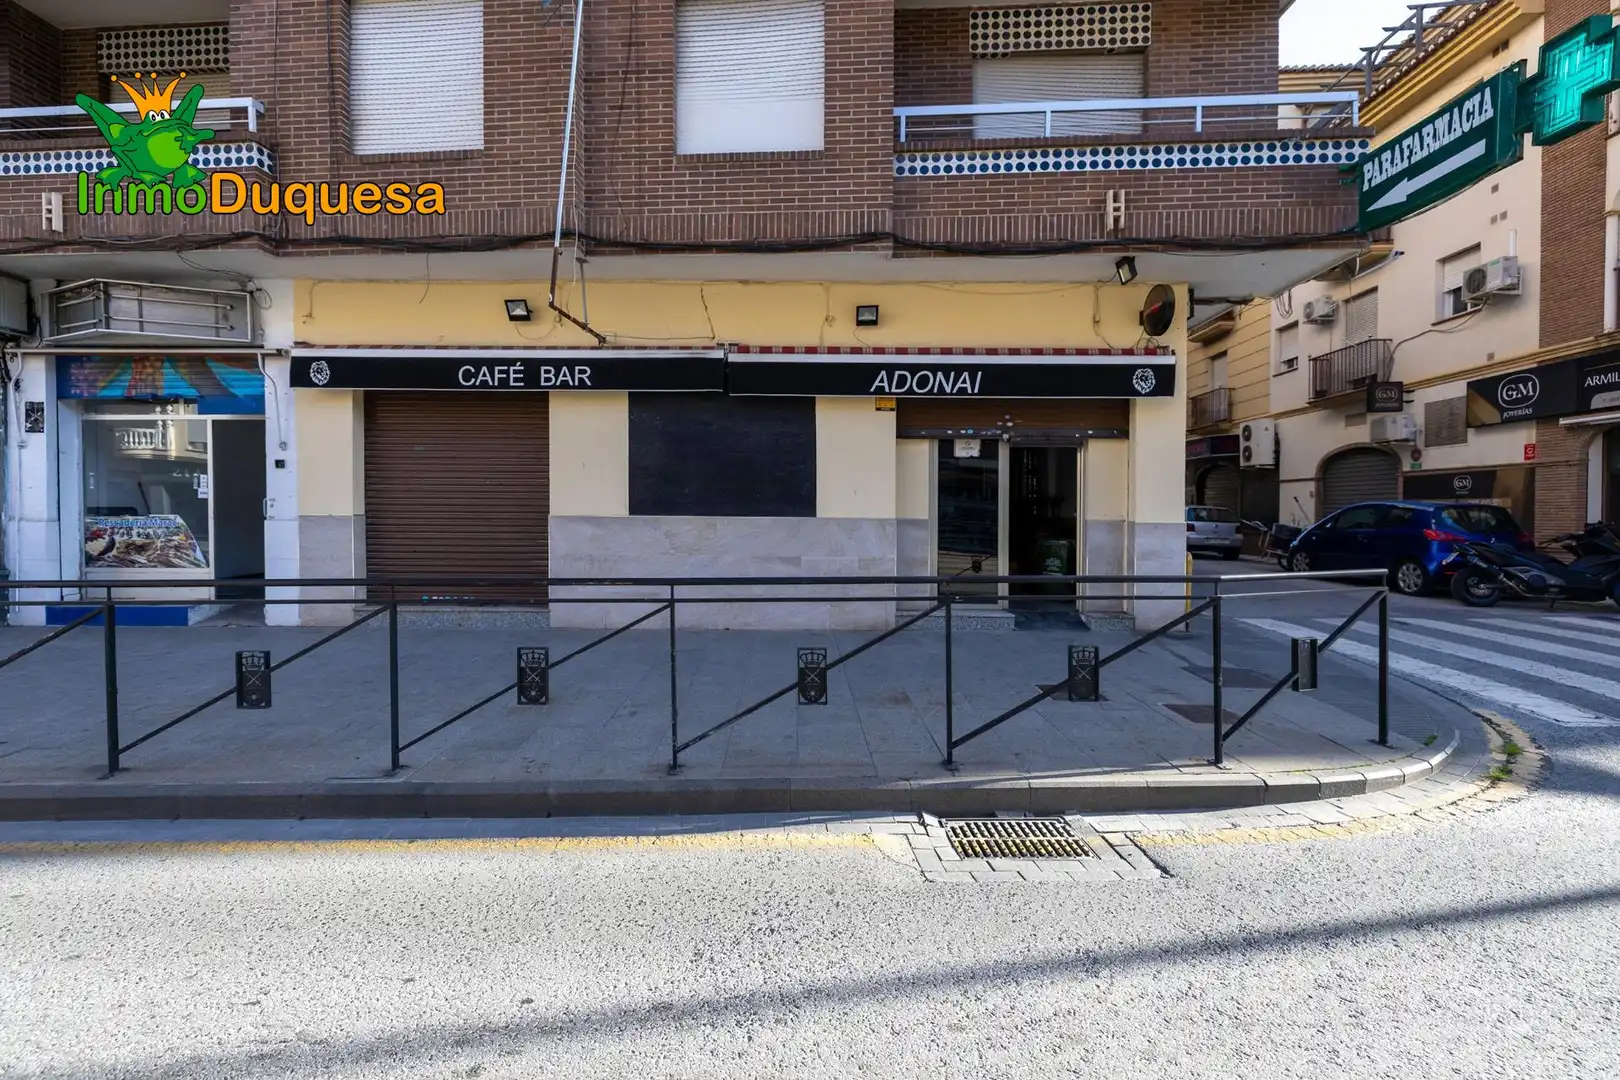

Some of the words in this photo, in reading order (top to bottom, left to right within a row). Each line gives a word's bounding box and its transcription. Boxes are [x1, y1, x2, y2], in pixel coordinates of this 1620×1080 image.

[1363, 86, 1494, 192] PARAFARMACIA
[458, 362, 525, 386] CAFÉ
[540, 366, 592, 386] BAR
[869, 370, 982, 394] ADONAI
[1378, 390, 1395, 399] GM
[1502, 381, 1535, 401] GM
